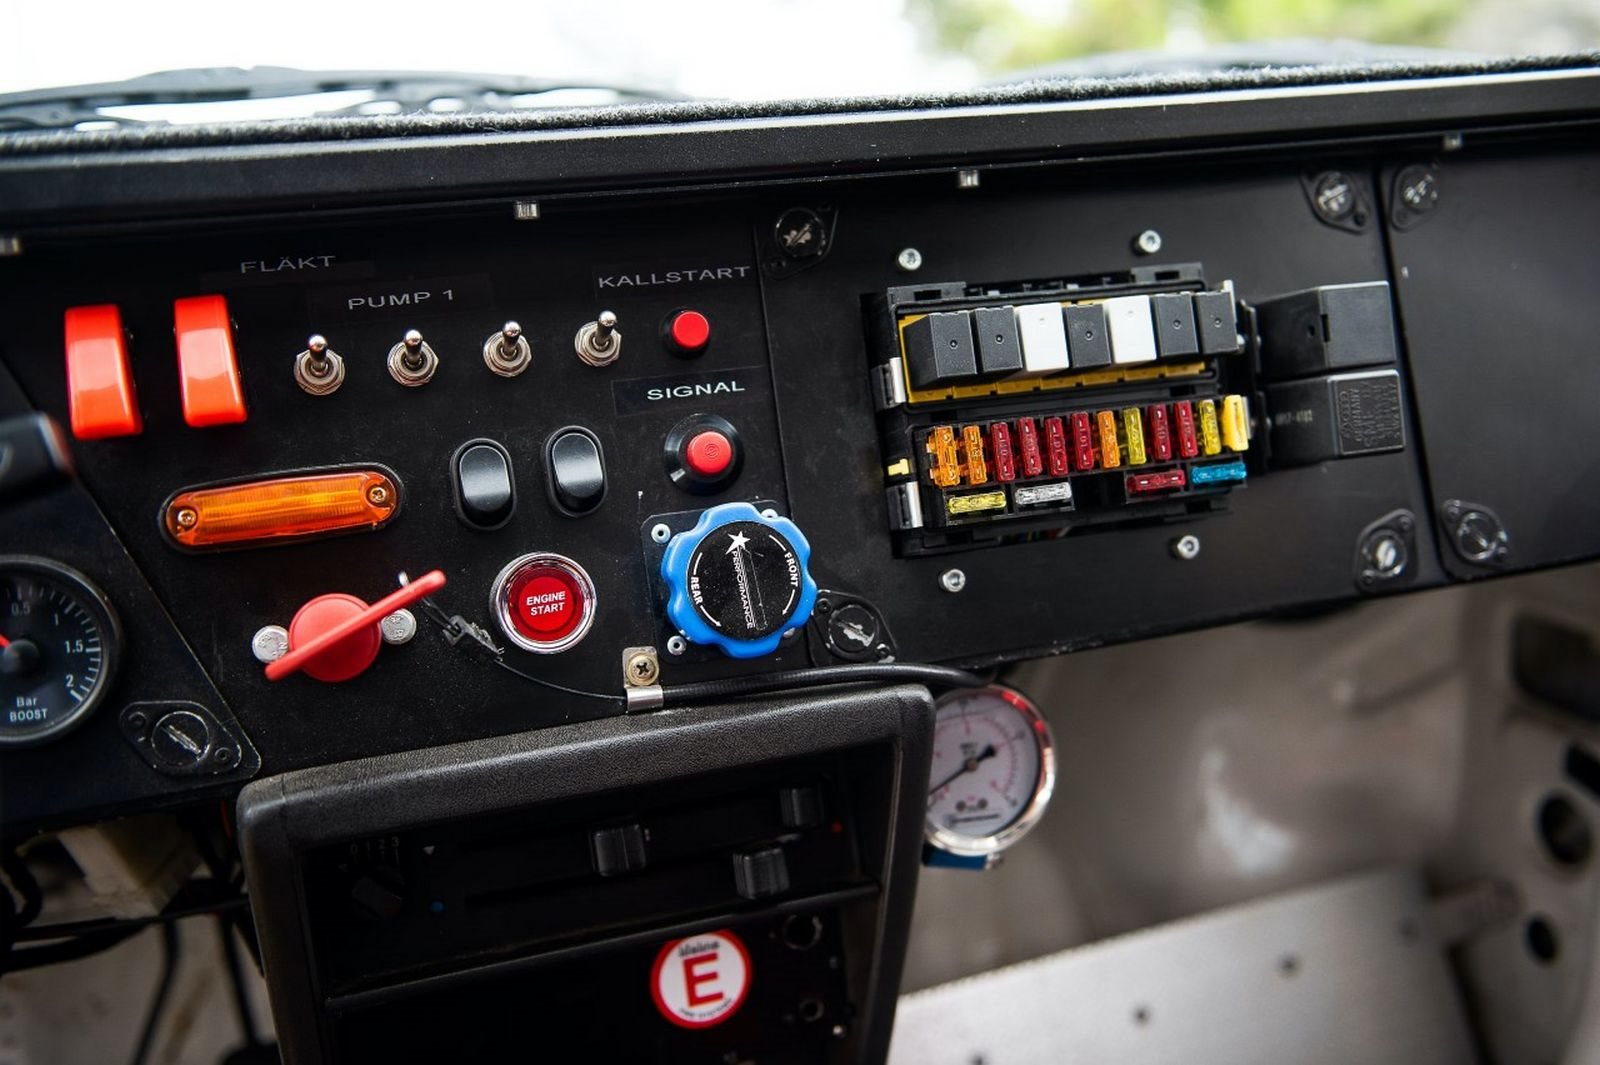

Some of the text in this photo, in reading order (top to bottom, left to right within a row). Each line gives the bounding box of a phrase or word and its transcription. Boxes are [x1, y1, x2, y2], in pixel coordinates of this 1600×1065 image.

[240, 255, 336, 274] FLÄKT
[598, 265, 750, 289] KALLSTART
[348, 289, 453, 310] PUMP 1
[647, 380, 746, 401] SIGNAL
[784, 551, 799, 588] FRONT
[526, 590, 566, 606] ENGINE
[690, 576, 704, 605] REAR
[12, 603, 31, 615] 0.5
[530, 602, 565, 616] START
[54, 613, 59, 626] 1
[65, 640, 84, 654] 1.5
[65, 674, 75, 688] 2
[16, 696, 38, 708] Bar
[9, 709, 48, 722] BOOST
[684, 953, 724, 1008] E
